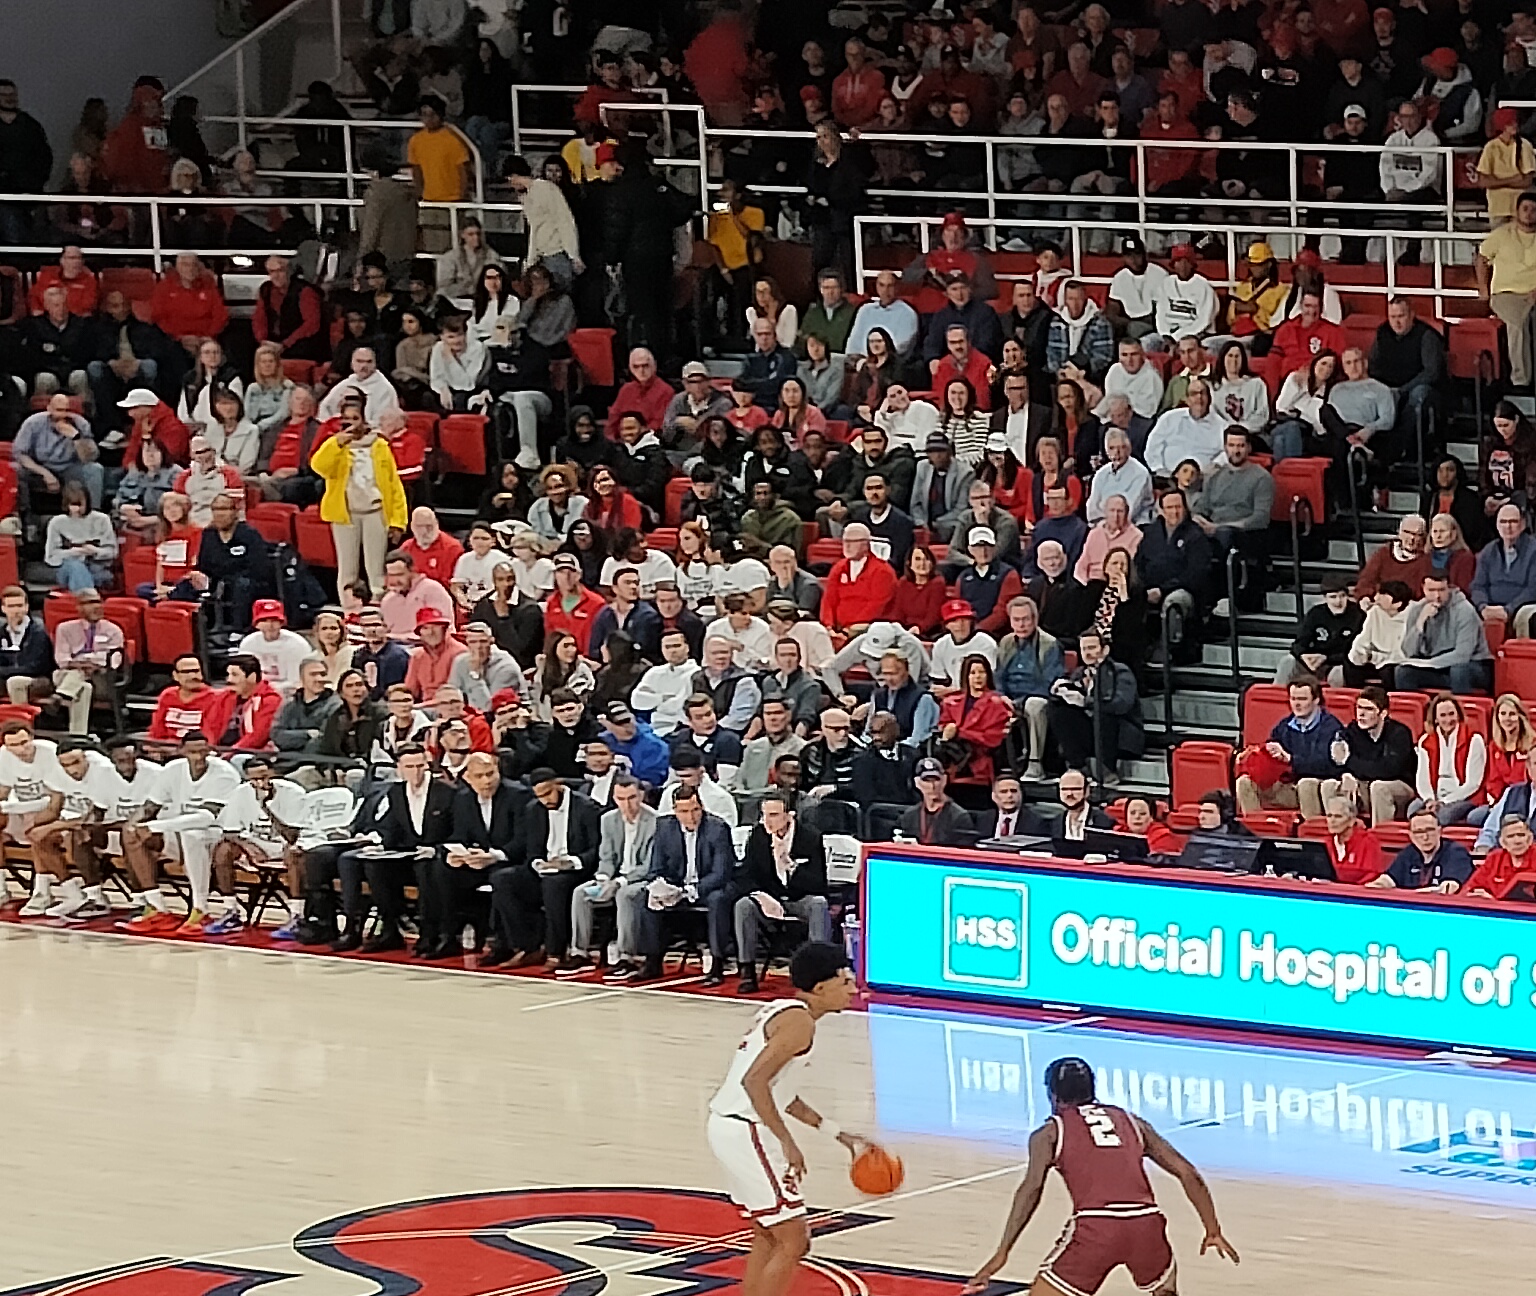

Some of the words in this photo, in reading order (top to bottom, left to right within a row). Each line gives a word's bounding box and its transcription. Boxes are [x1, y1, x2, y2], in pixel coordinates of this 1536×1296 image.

[955, 913, 1019, 950] HSS
[1050, 910, 1223, 978] Official
[1239, 929, 1449, 1003] Hospital
[1461, 953, 1520, 1008] of
